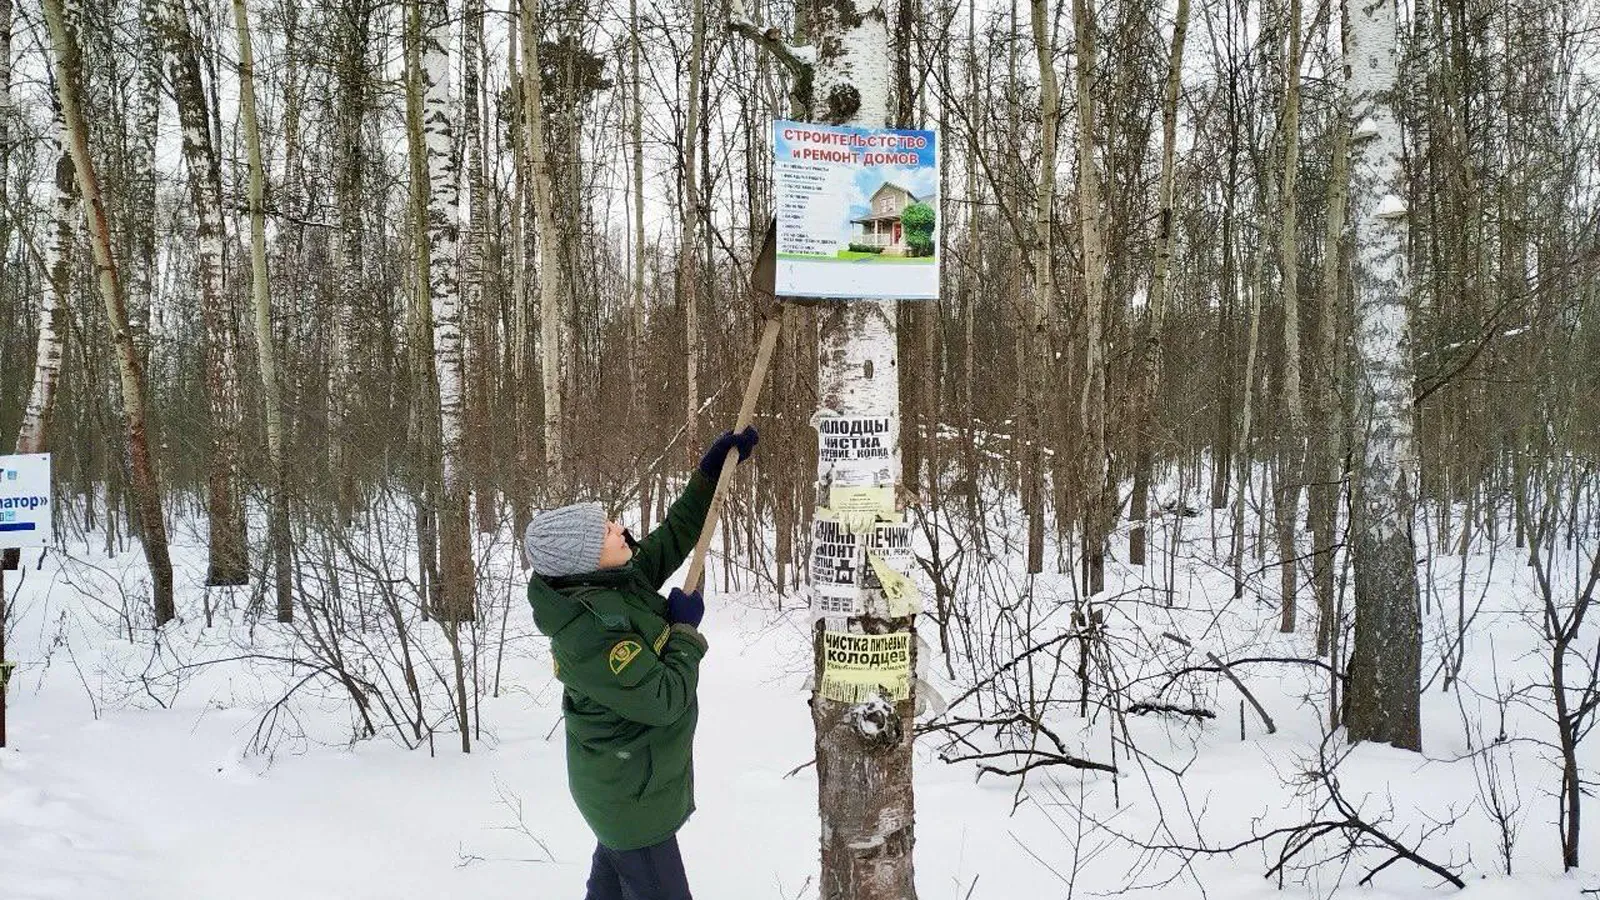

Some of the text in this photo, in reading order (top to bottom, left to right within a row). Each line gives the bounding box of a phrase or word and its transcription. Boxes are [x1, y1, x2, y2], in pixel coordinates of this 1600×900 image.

[803, 148, 859, 164] РЕМОНТ
[863, 152, 918, 167] ДОМОВ
[824, 436, 881, 450] ЧИСТКА
[857, 447, 889, 458] КОПКА
